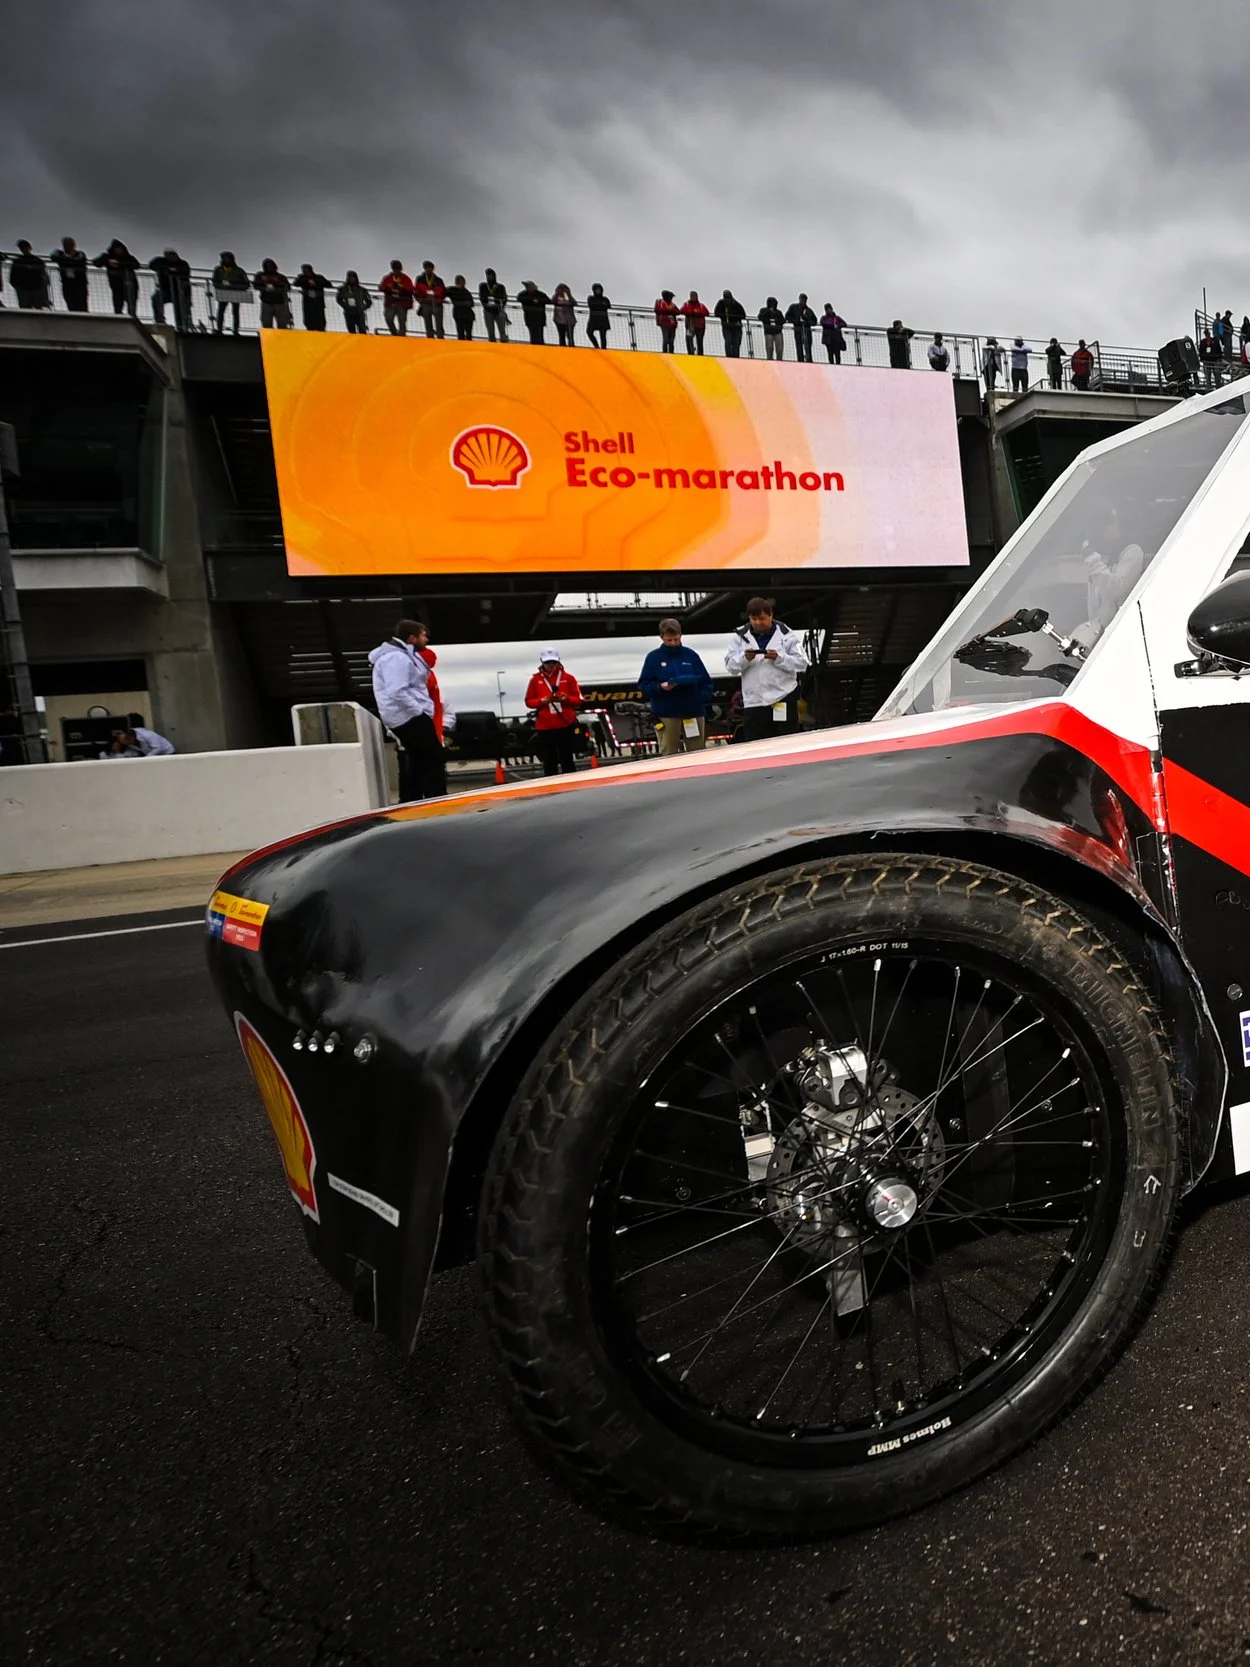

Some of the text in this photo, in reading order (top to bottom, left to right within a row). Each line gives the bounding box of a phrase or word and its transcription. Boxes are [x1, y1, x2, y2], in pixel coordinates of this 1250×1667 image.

[564, 430, 635, 454] Shell
[565, 457, 845, 492] Eco-marathon
[869, 943, 888, 951] DOT
[1065, 960, 1163, 1130] MICHELIN
[867, 1416, 952, 1456] Holmes MMP
